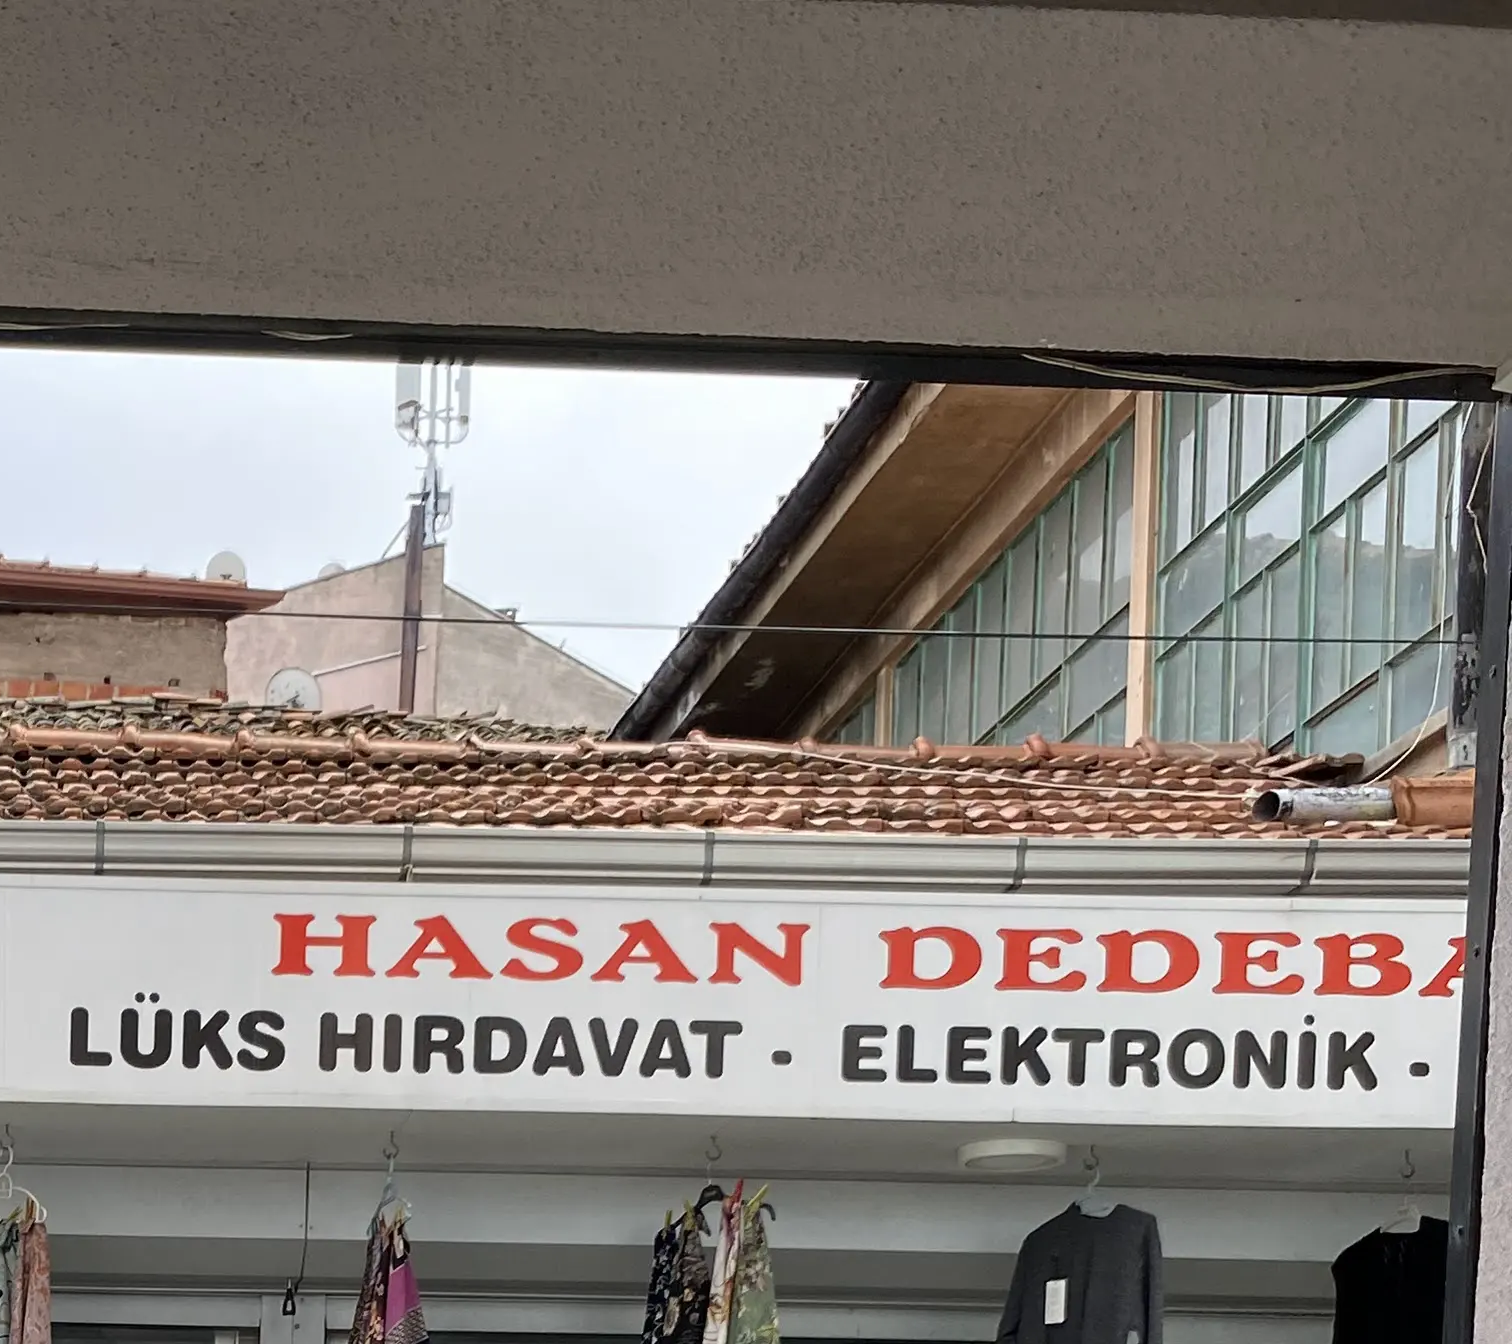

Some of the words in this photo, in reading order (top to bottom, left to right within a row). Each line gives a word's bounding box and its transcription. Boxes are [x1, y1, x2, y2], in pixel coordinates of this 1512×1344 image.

[270, 912, 813, 988] HASAN
[69, 991, 287, 1073] LÜKS
[318, 1011, 744, 1080] HIRDAVAT
[840, 1014, 1379, 1093] ELEKTRONİK
